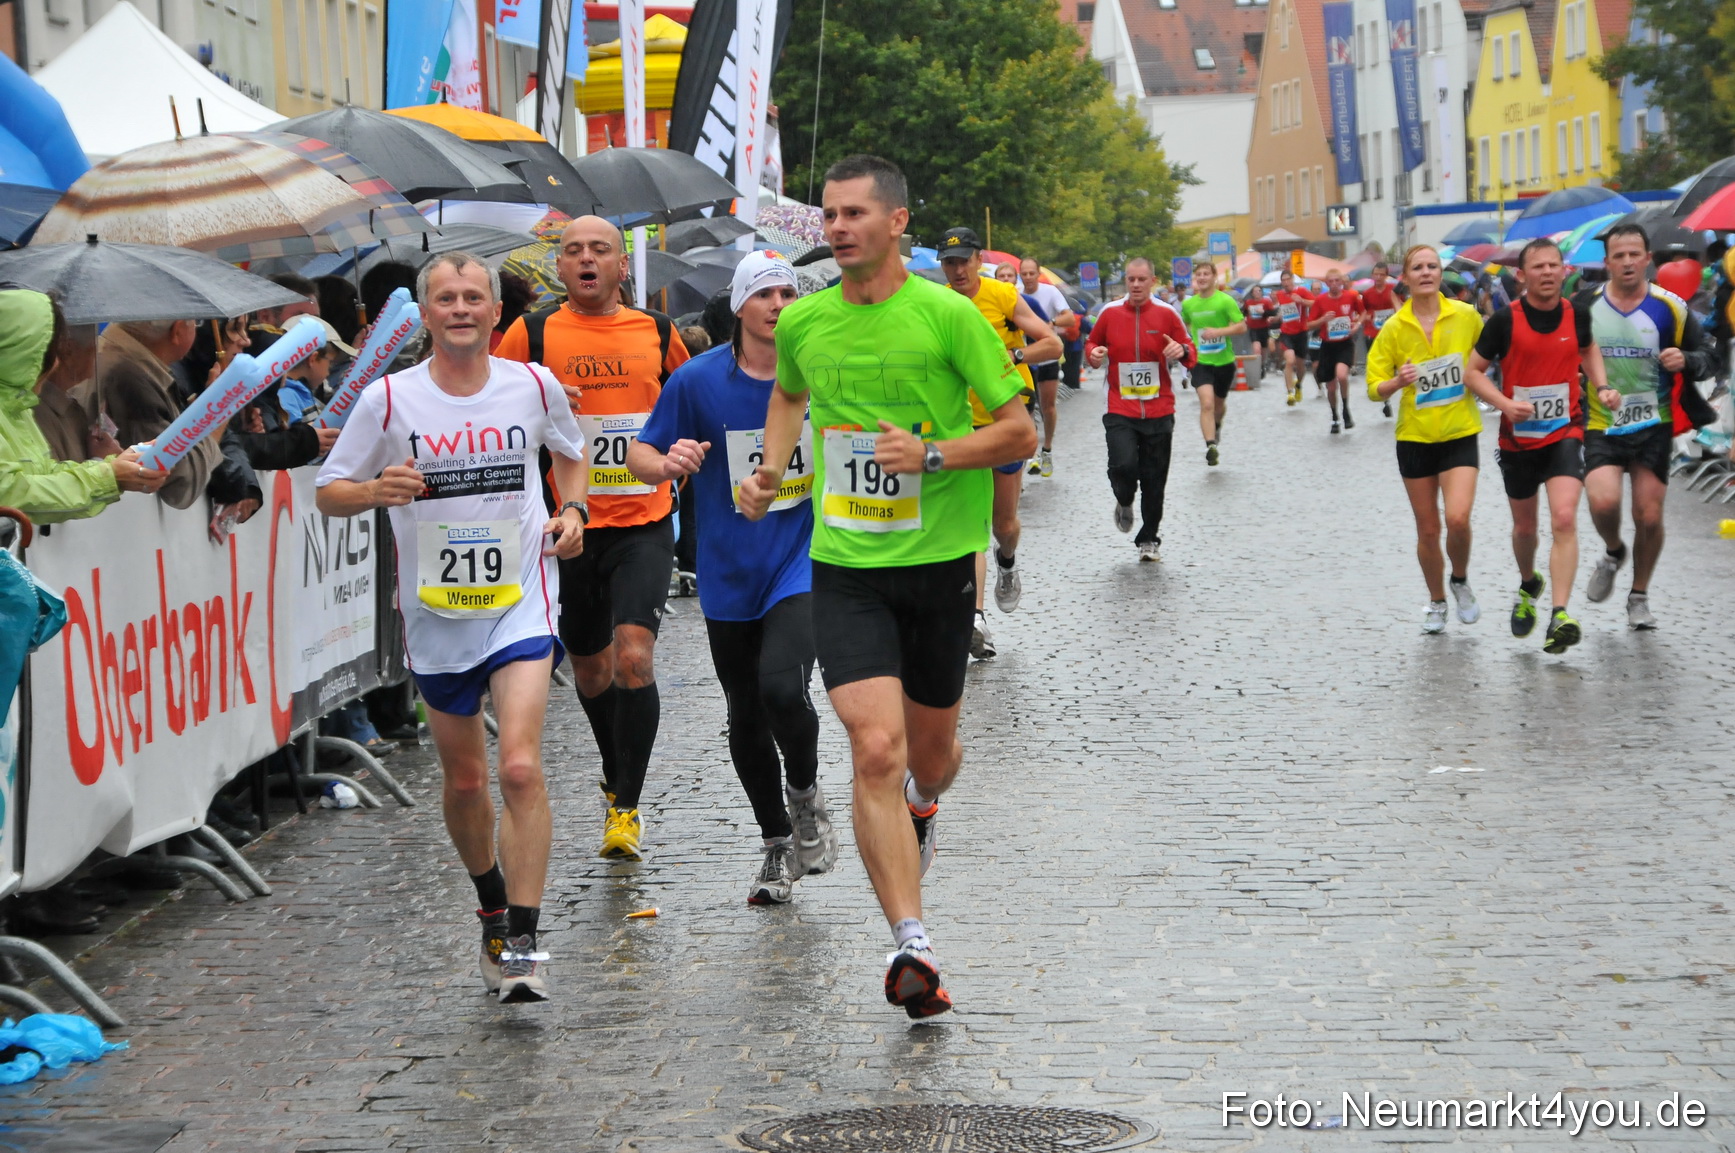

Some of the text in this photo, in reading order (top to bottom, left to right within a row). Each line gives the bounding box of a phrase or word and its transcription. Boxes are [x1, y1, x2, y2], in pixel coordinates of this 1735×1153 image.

[1403, 55, 1419, 122] RUPPERT
[745, 68, 758, 175] Audi
[1504, 102, 1523, 124] HOTEL
[1600, 337, 1634, 345] TEAM
[1600, 346, 1653, 358] BOCK
[329, 317, 414, 416] TUI ReiseCenter
[575, 361, 629, 378] OEXL
[1128, 371, 1151, 386] 126
[1419, 366, 1461, 392] 3410
[163, 380, 249, 457] TUI ReiseCenter
[408, 421, 526, 459] twinn
[469, 456, 477, 465] &
[480, 452, 526, 464] Akademie
[593, 436, 638, 466] 20
[748, 445, 805, 477] 24
[424, 472, 460, 485] TWINN
[464, 472, 481, 481] der
[438, 480, 475, 492] persönlich
[482, 477, 523, 488] wirtschaftlich
[594, 472, 642, 483] Christia
[844, 458, 900, 496] 198
[776, 483, 806, 498] nnes
[848, 501, 894, 518] Thomas
[448, 527, 491, 538] BOCK
[440, 547, 502, 583] 219
[447, 591, 496, 606] Werner
[62, 533, 256, 786] Oberbank
